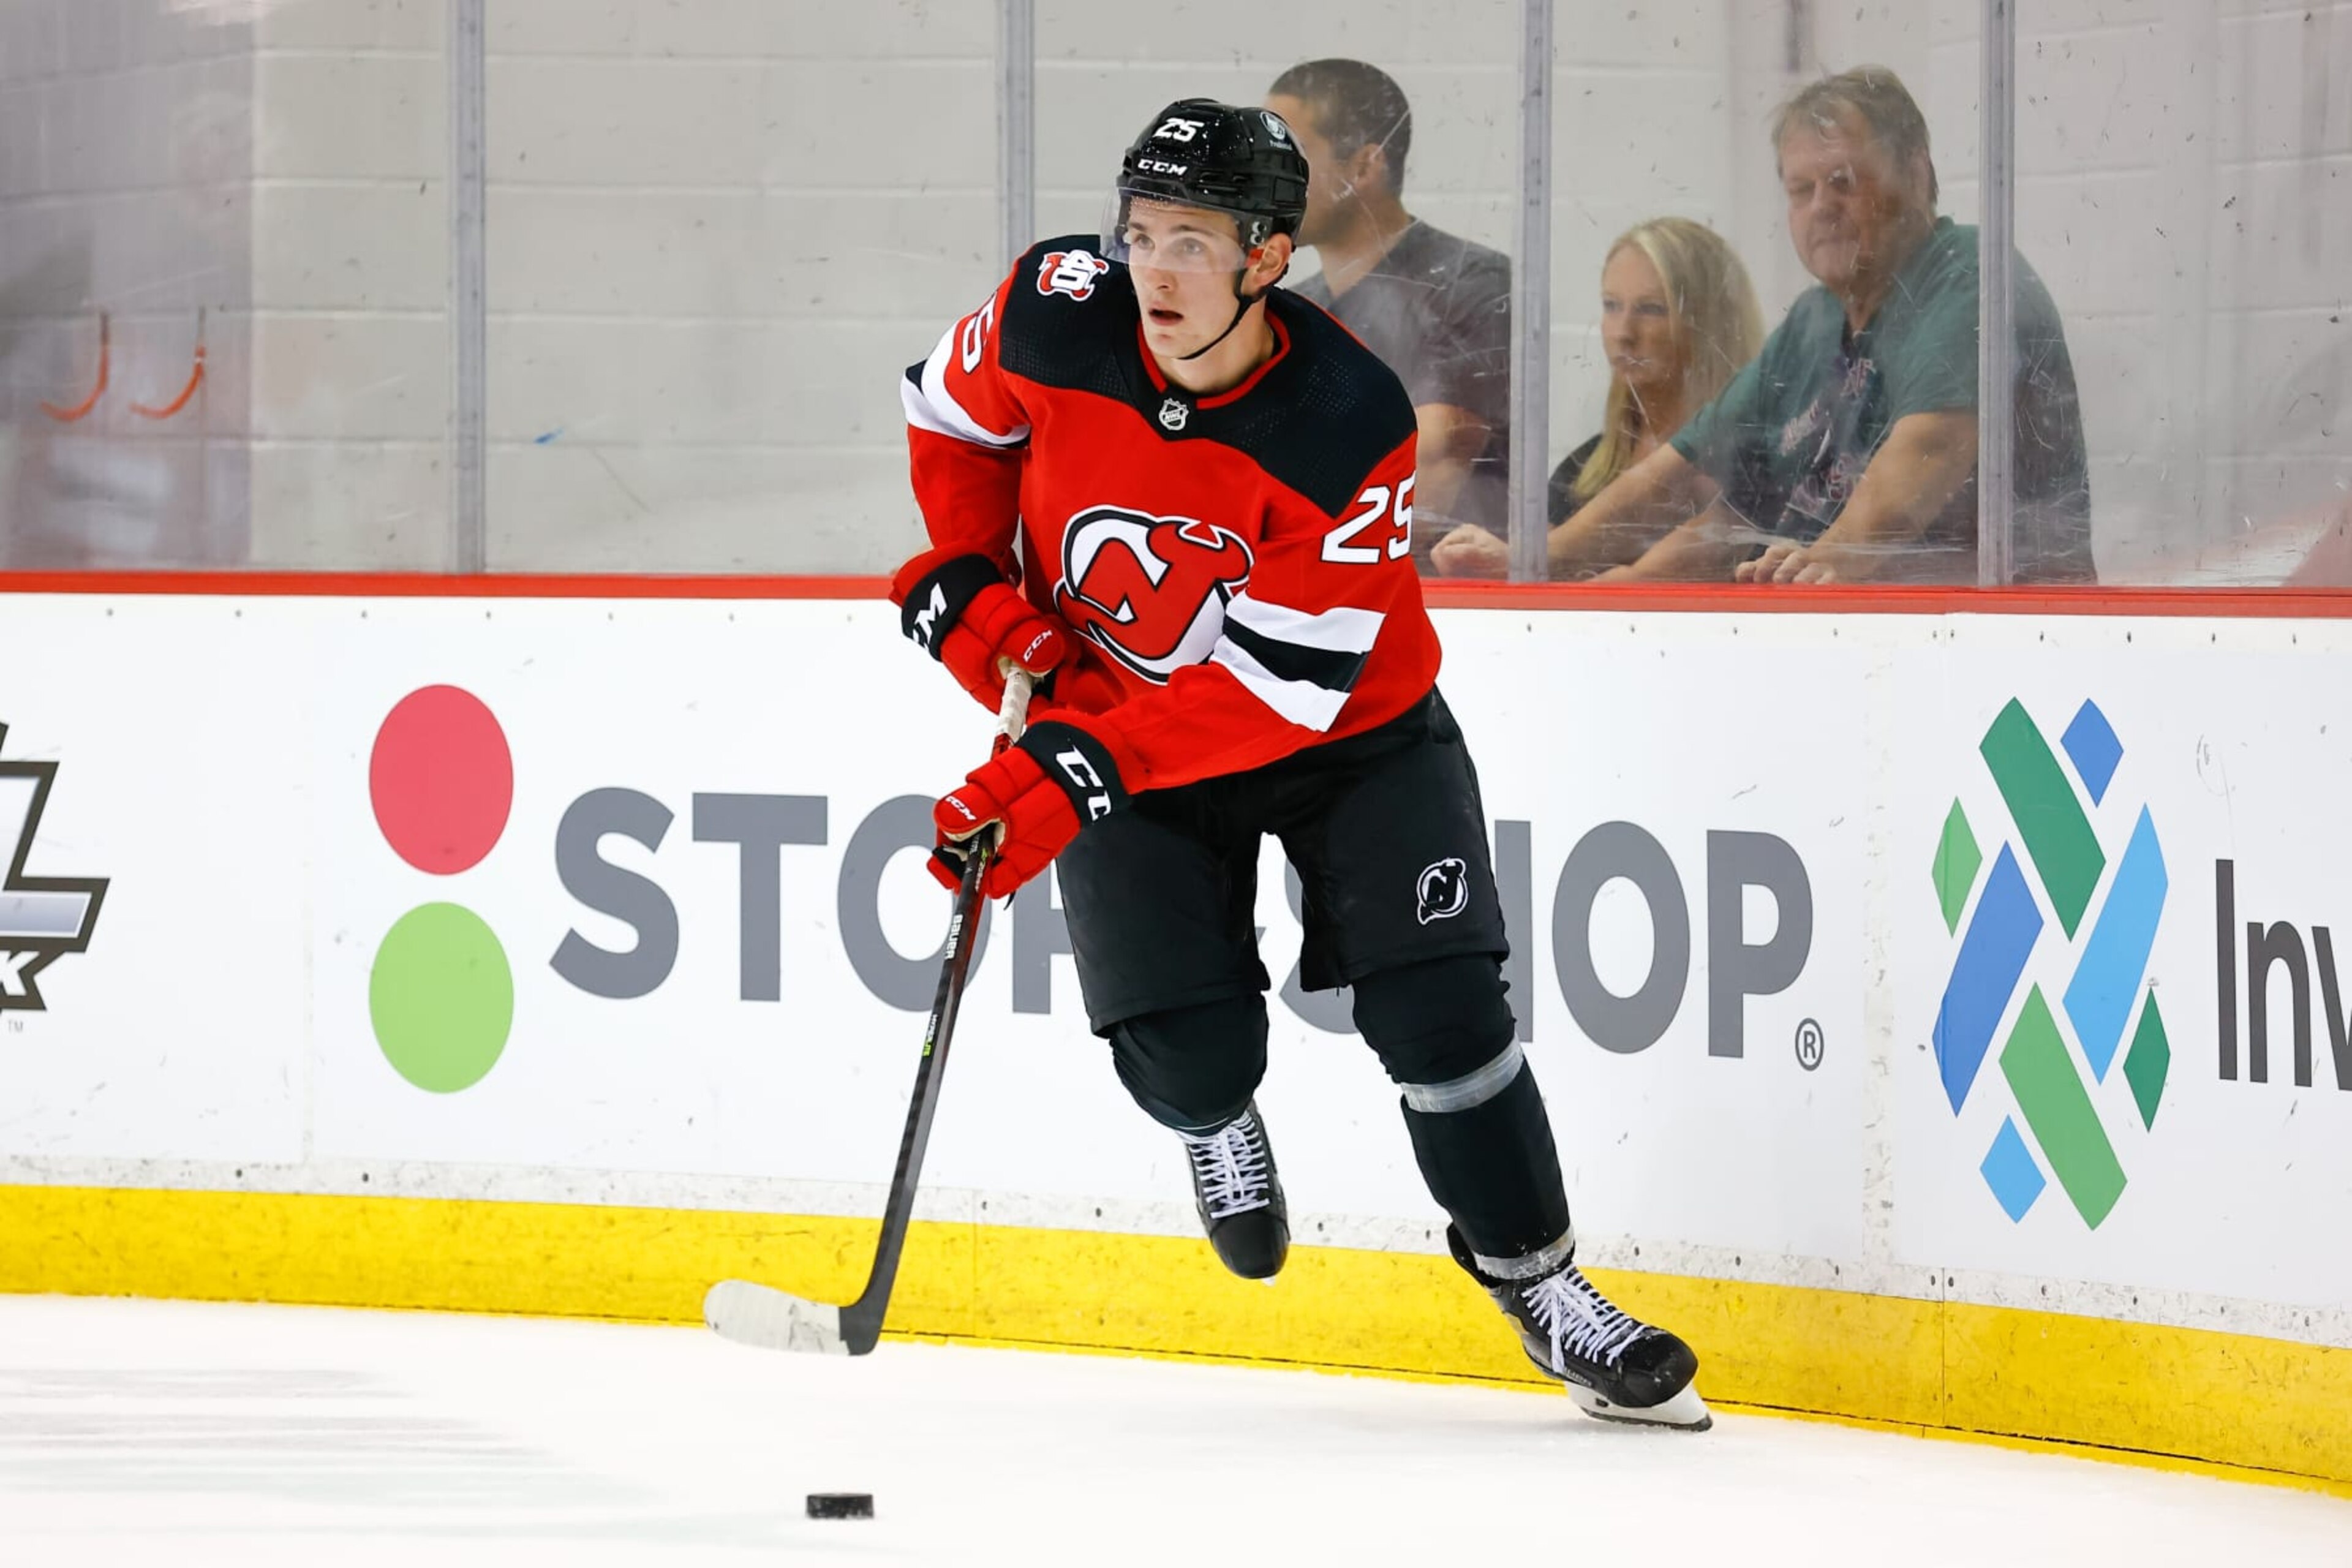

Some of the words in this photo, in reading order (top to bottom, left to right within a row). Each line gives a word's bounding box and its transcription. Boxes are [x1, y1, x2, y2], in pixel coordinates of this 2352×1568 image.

[1153, 117, 1205, 142] 25
[1137, 158, 1188, 176] CCM
[1320, 470, 1417, 565] 25
[1022, 629, 1053, 663] CCM
